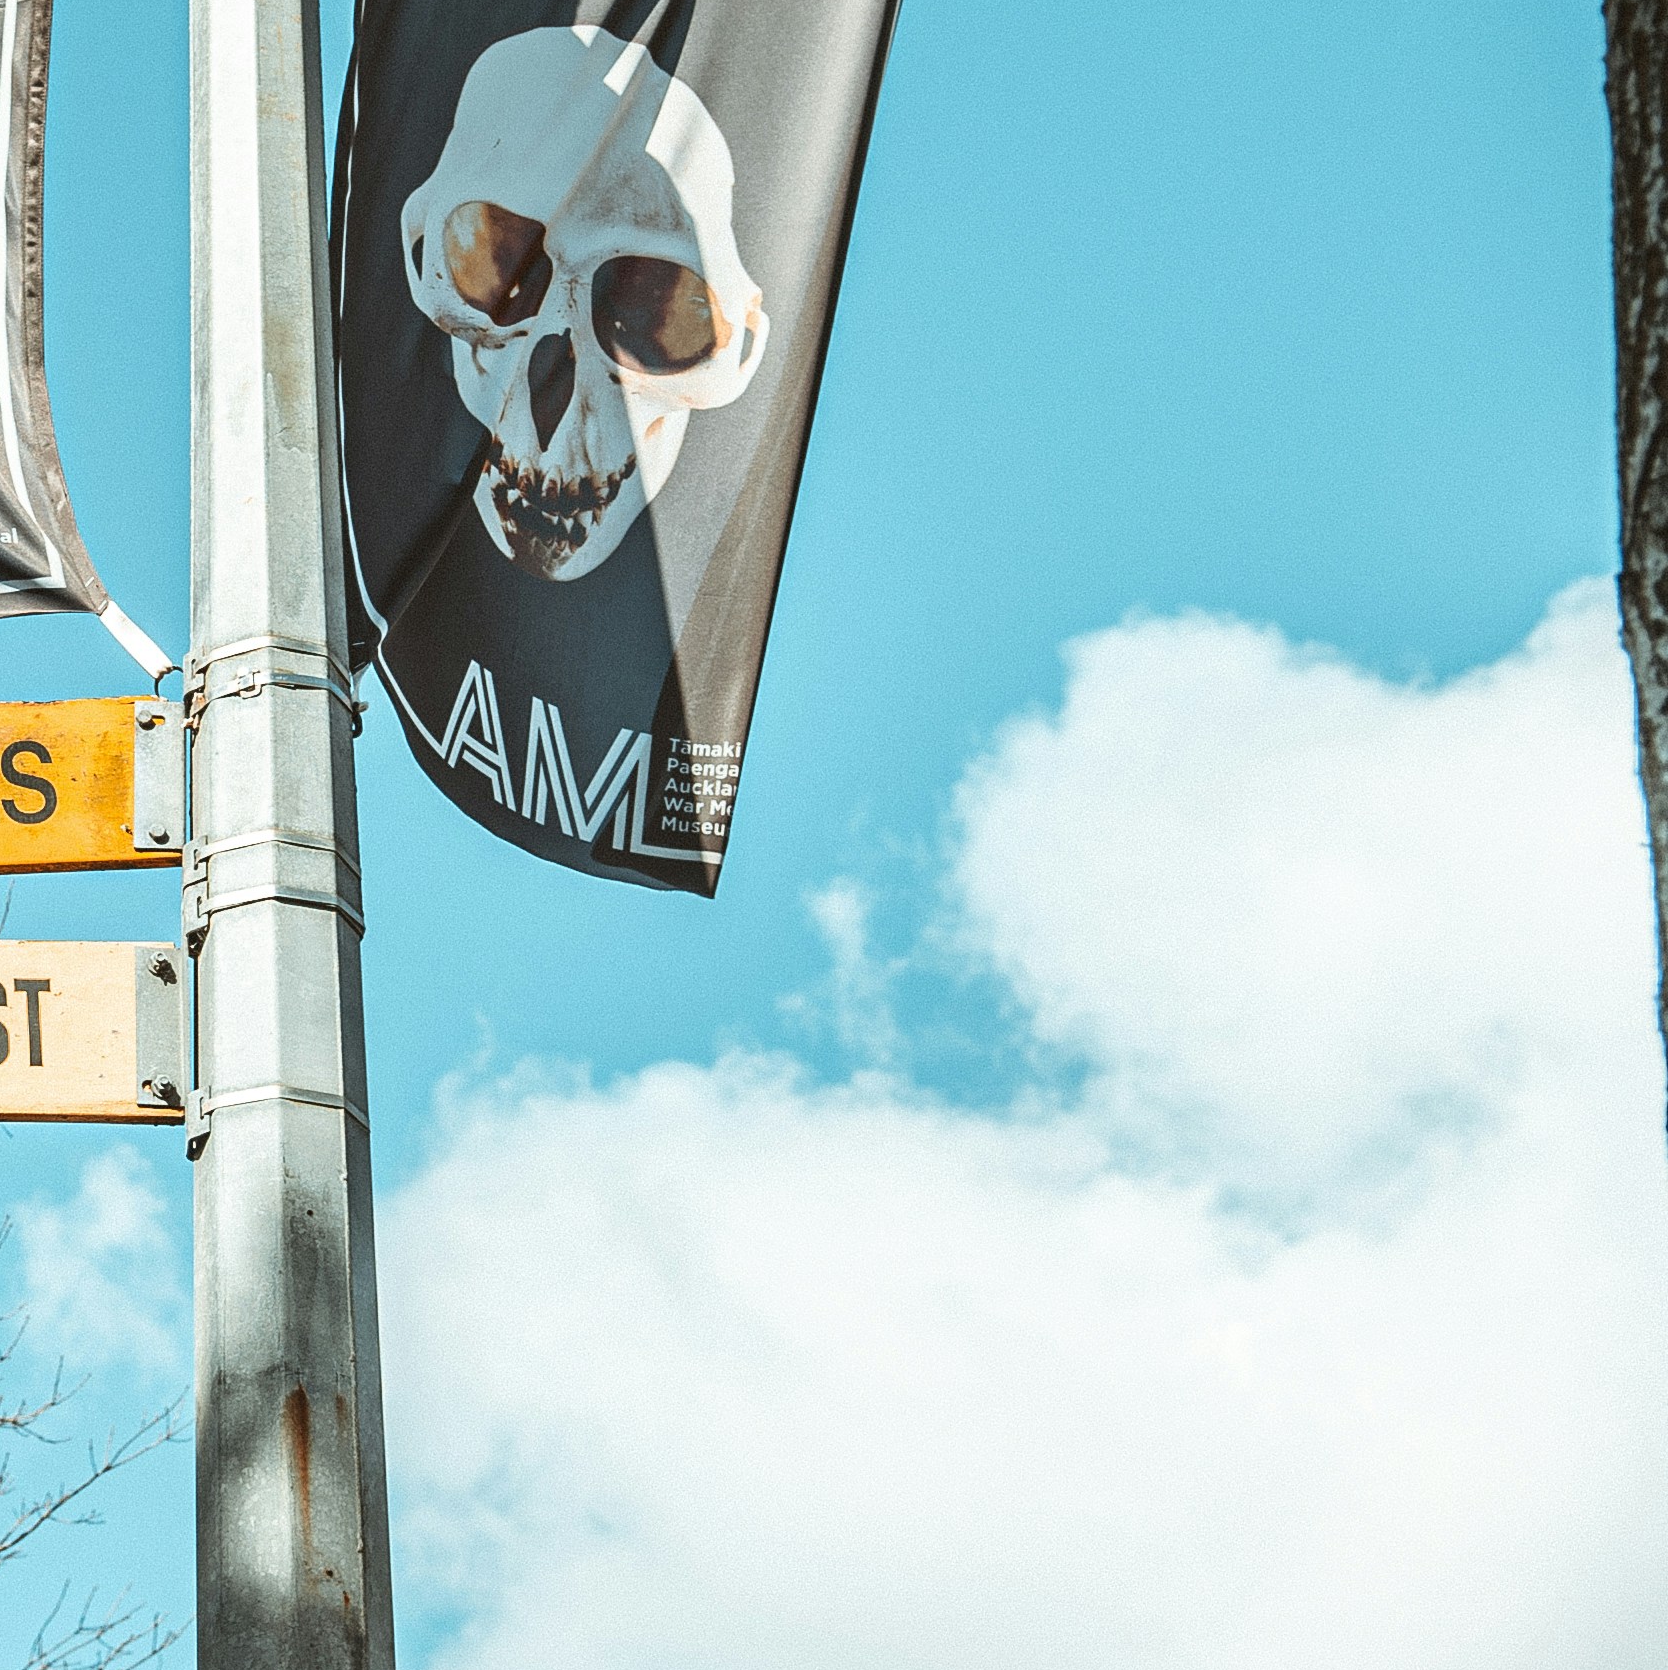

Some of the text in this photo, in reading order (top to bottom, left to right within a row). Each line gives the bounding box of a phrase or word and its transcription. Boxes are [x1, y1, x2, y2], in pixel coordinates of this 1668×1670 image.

[438, 659, 653, 854] AM
[667, 757, 740, 780] Paenga
[664, 796, 705, 814] War
[661, 816, 726, 837] Museu
